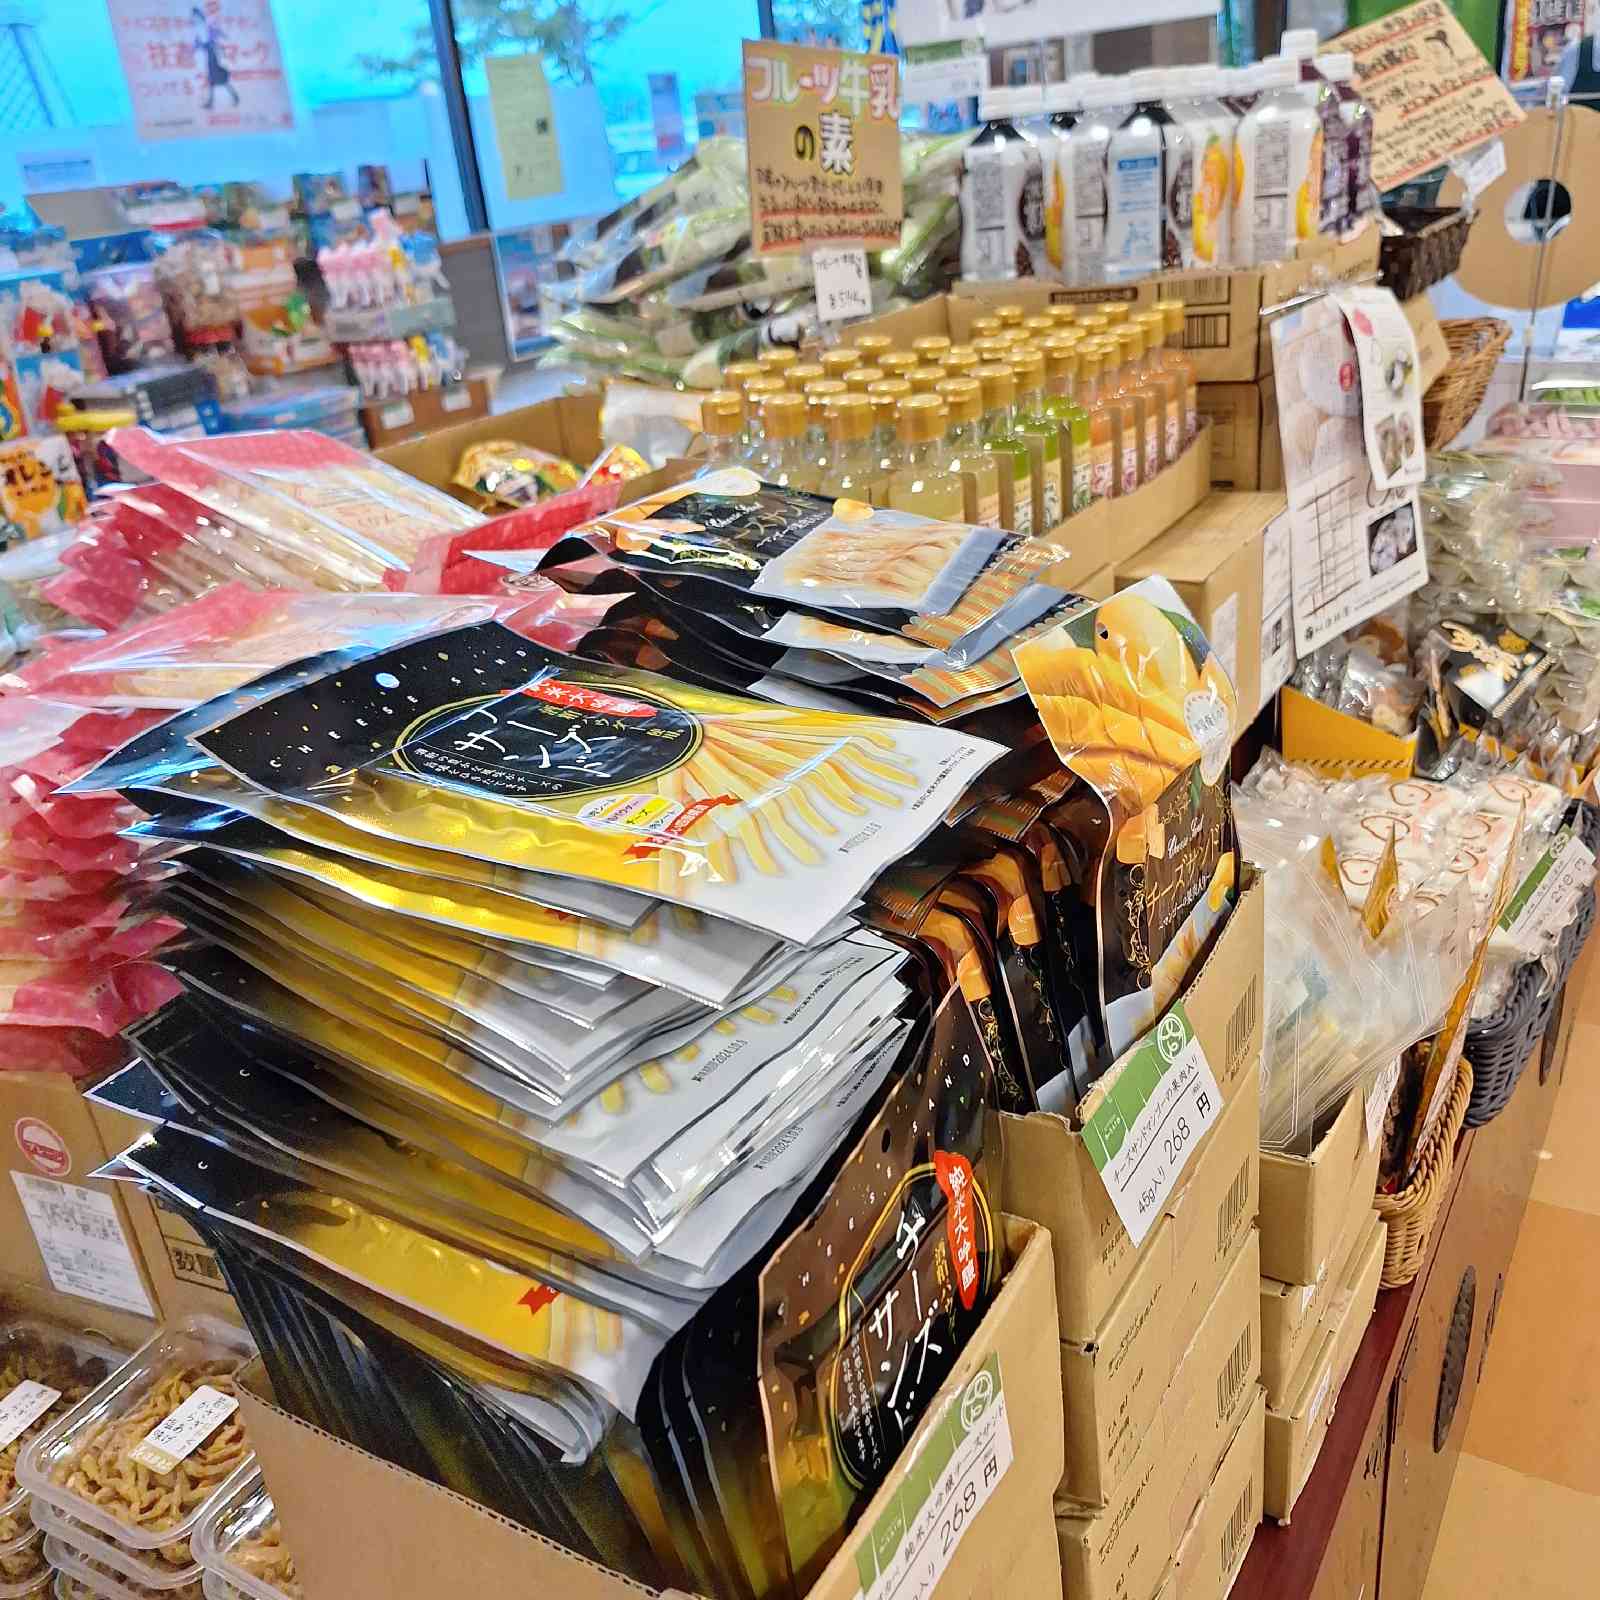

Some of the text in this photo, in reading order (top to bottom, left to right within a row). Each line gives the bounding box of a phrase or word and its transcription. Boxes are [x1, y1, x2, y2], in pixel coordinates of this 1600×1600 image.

[745, 57, 898, 119] フルーツ牛乳
[794, 110, 853, 176] の素
[269, 694, 418, 769] CHEESE
[1138, 1091, 1211, 1215] 45g入り 268 円
[949, 1166, 978, 1292] 純米大吟醸
[941, 1481, 977, 1556] 268
[983, 1455, 999, 1488] 円
